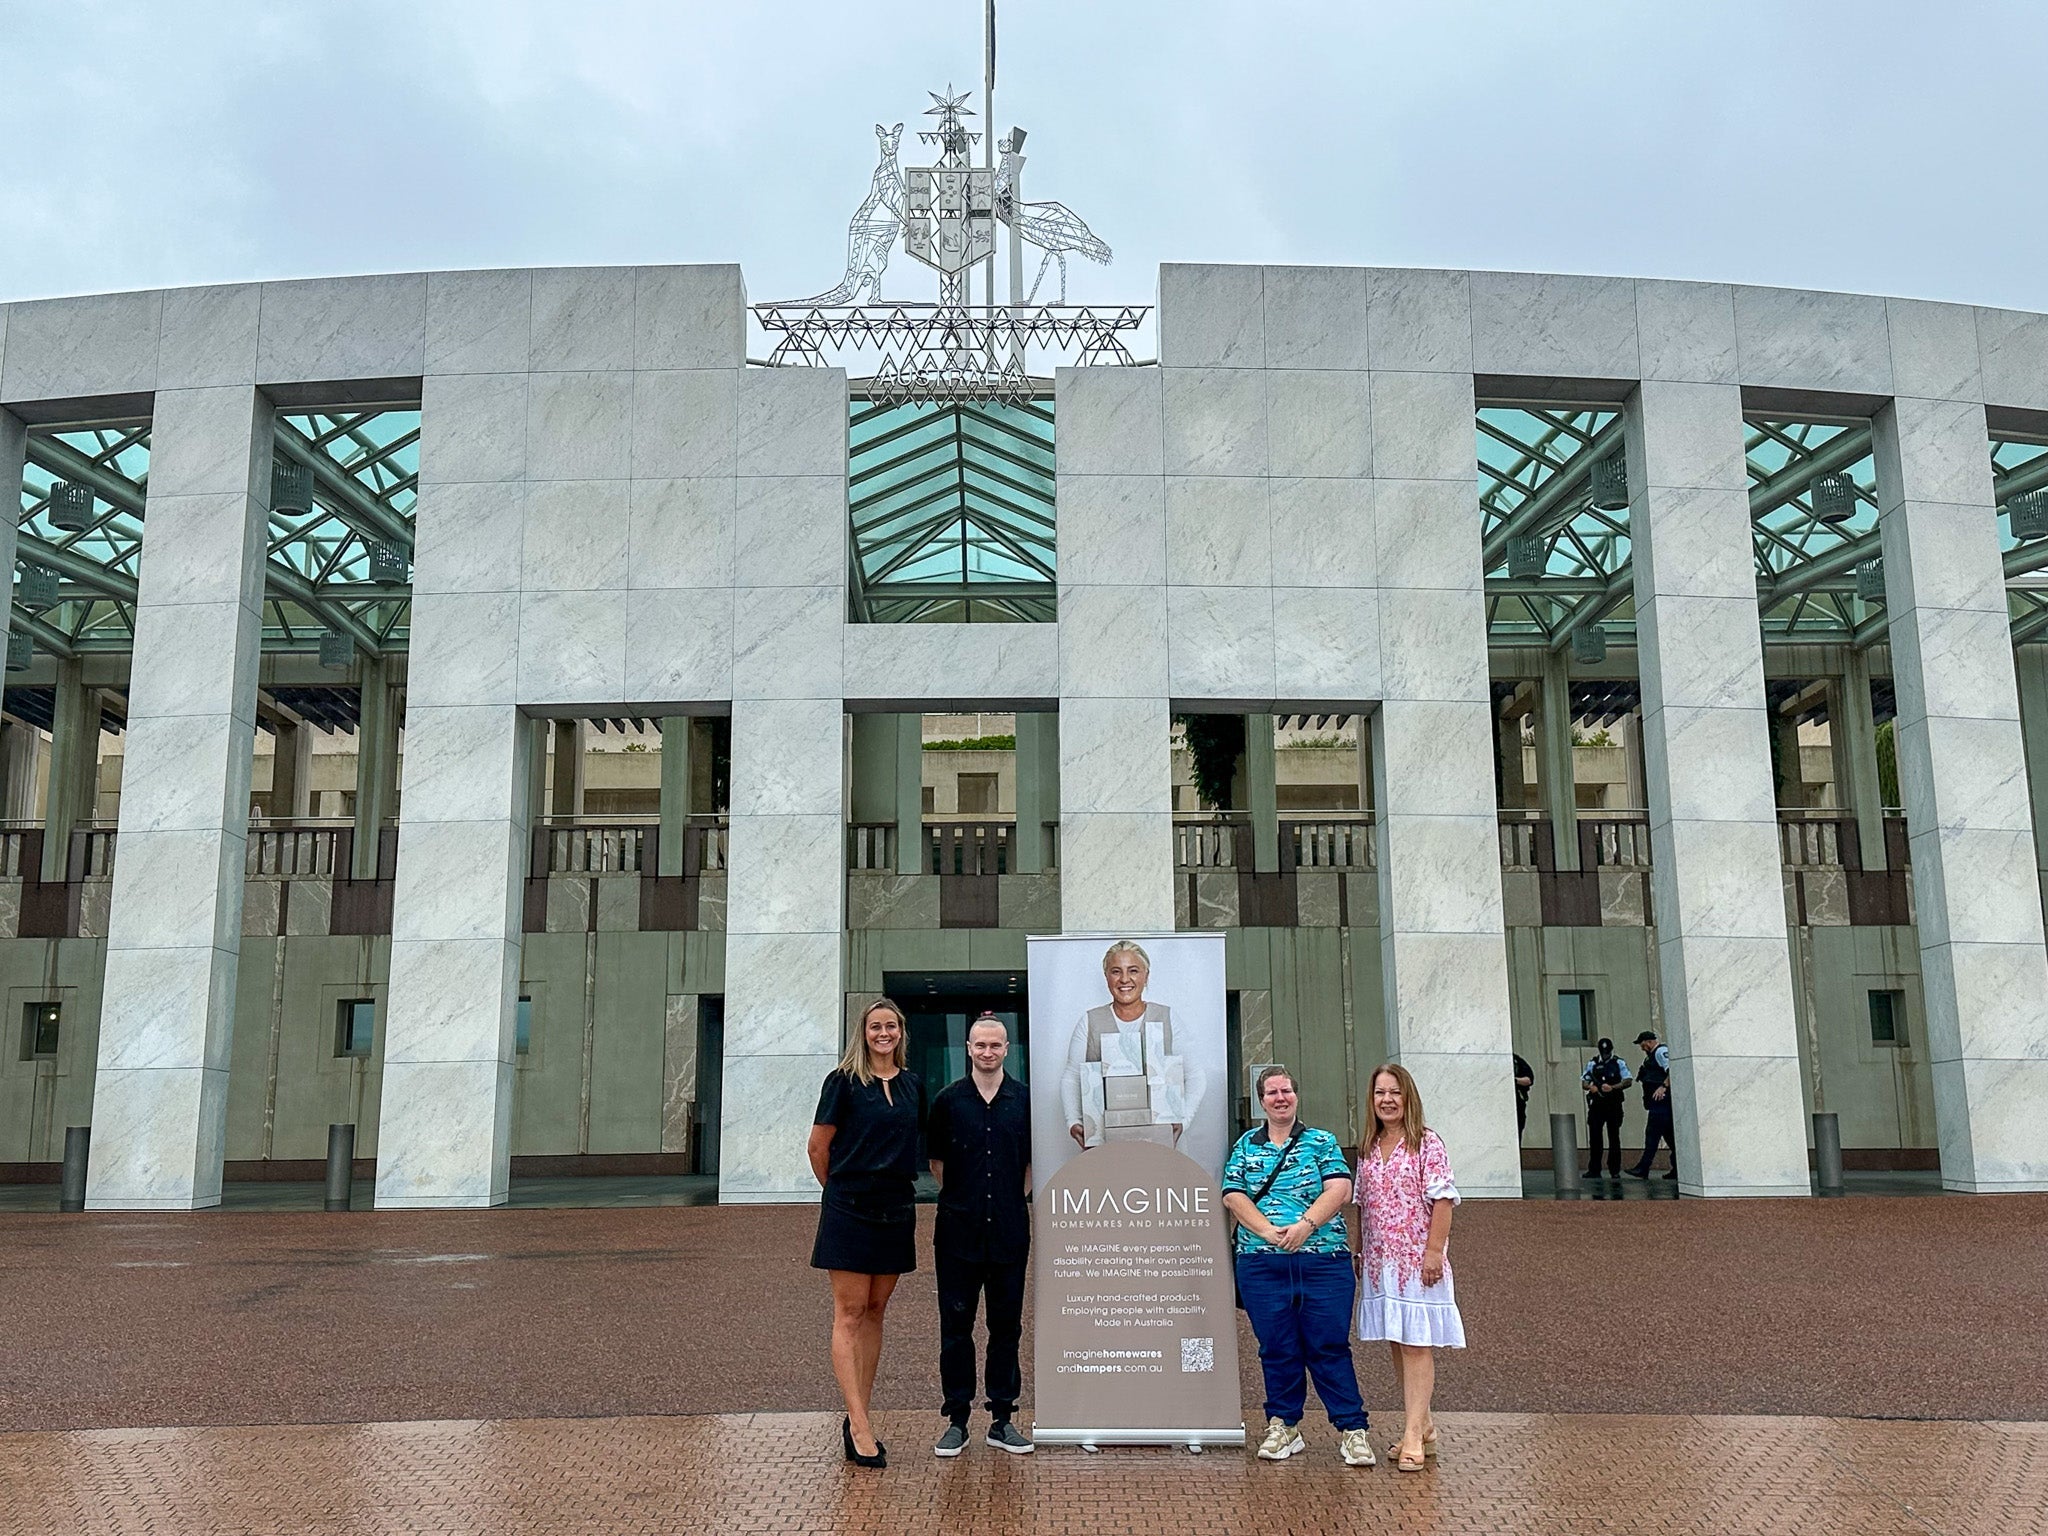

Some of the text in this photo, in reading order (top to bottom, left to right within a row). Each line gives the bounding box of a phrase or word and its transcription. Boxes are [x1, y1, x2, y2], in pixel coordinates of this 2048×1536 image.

[879, 368, 1023, 387] AUSTRALIA
[1051, 1188, 1210, 1214] IMAGINE
[1052, 1219, 1211, 1229] HOMEWARES AND HAMPERS
[1064, 1243, 1202, 1254] We IMAGINE every person with
[1053, 1257, 1092, 1266] disability
[1095, 1257, 1133, 1266] creating
[1135, 1257, 1156, 1265] their
[1179, 1256, 1214, 1266] positive
[1054, 1268, 1213, 1278] future. We IMAGINE the possibilities!
[1066, 1293, 1200, 1303] Luxury hand-crafted products
[1061, 1305, 1206, 1316] Employing people with disability
[1094, 1318, 1174, 1327] Made in Australia
[1063, 1349, 1163, 1360] imaginehomewares
